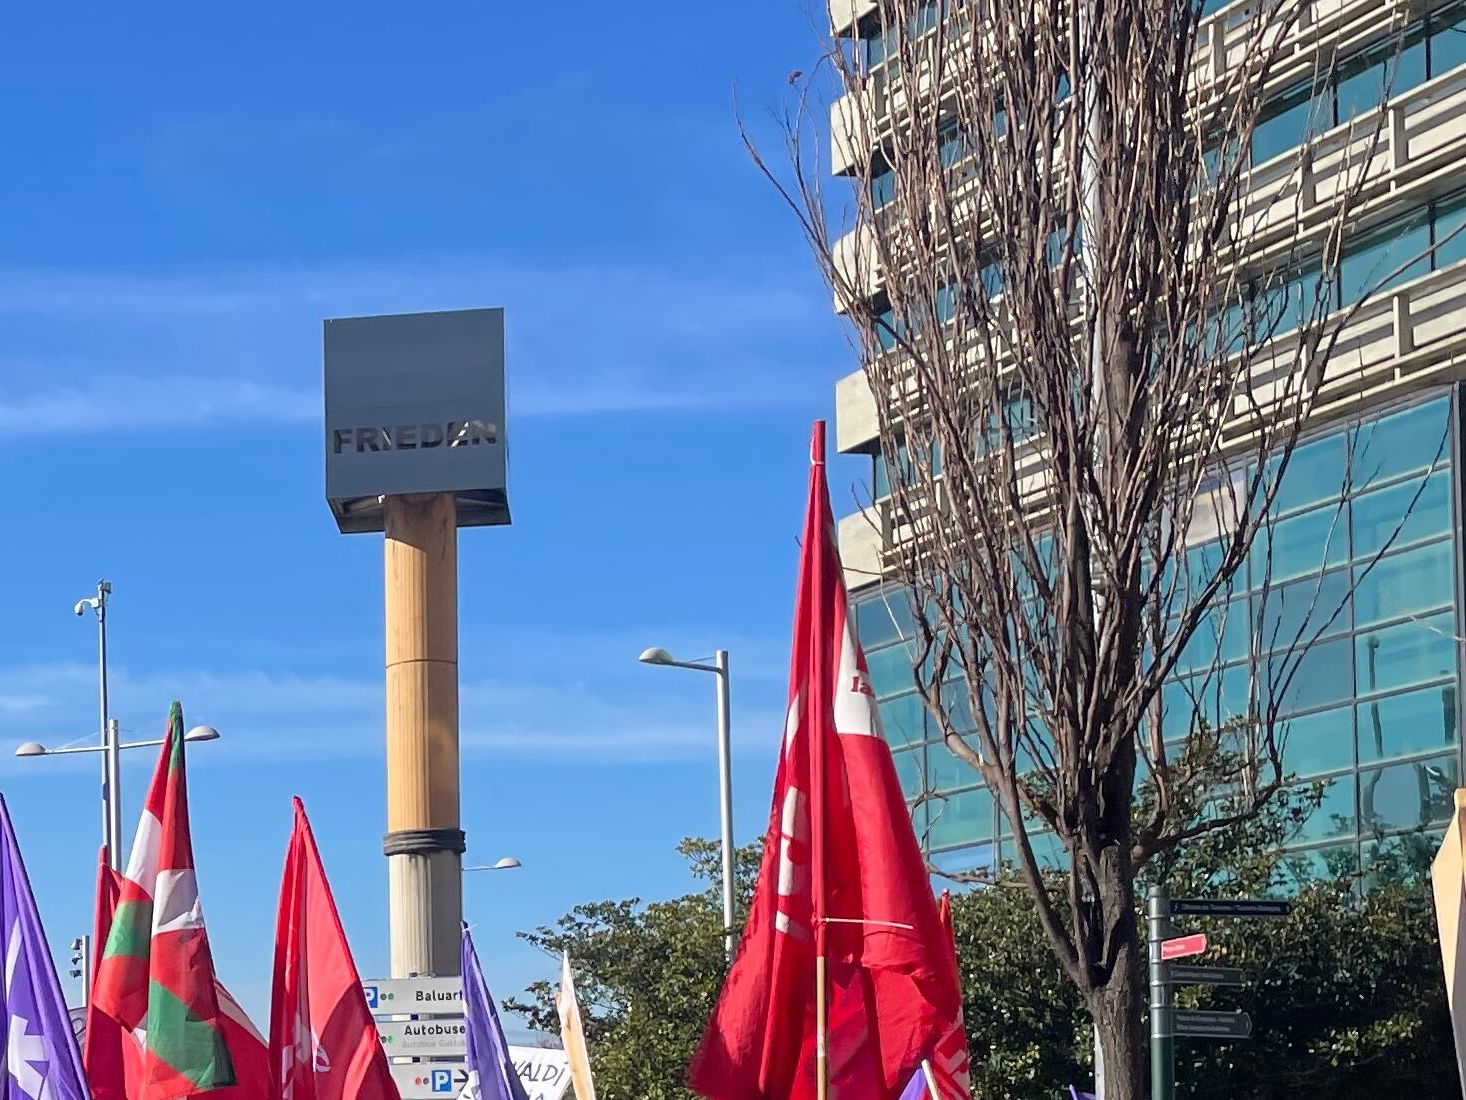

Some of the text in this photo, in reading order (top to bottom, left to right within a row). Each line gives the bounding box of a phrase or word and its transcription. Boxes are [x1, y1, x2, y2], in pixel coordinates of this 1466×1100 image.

[334, 420, 497, 454] FRIEDEN
[415, 989, 464, 1002] Baluart
[404, 1024, 466, 1036] Autobuse
